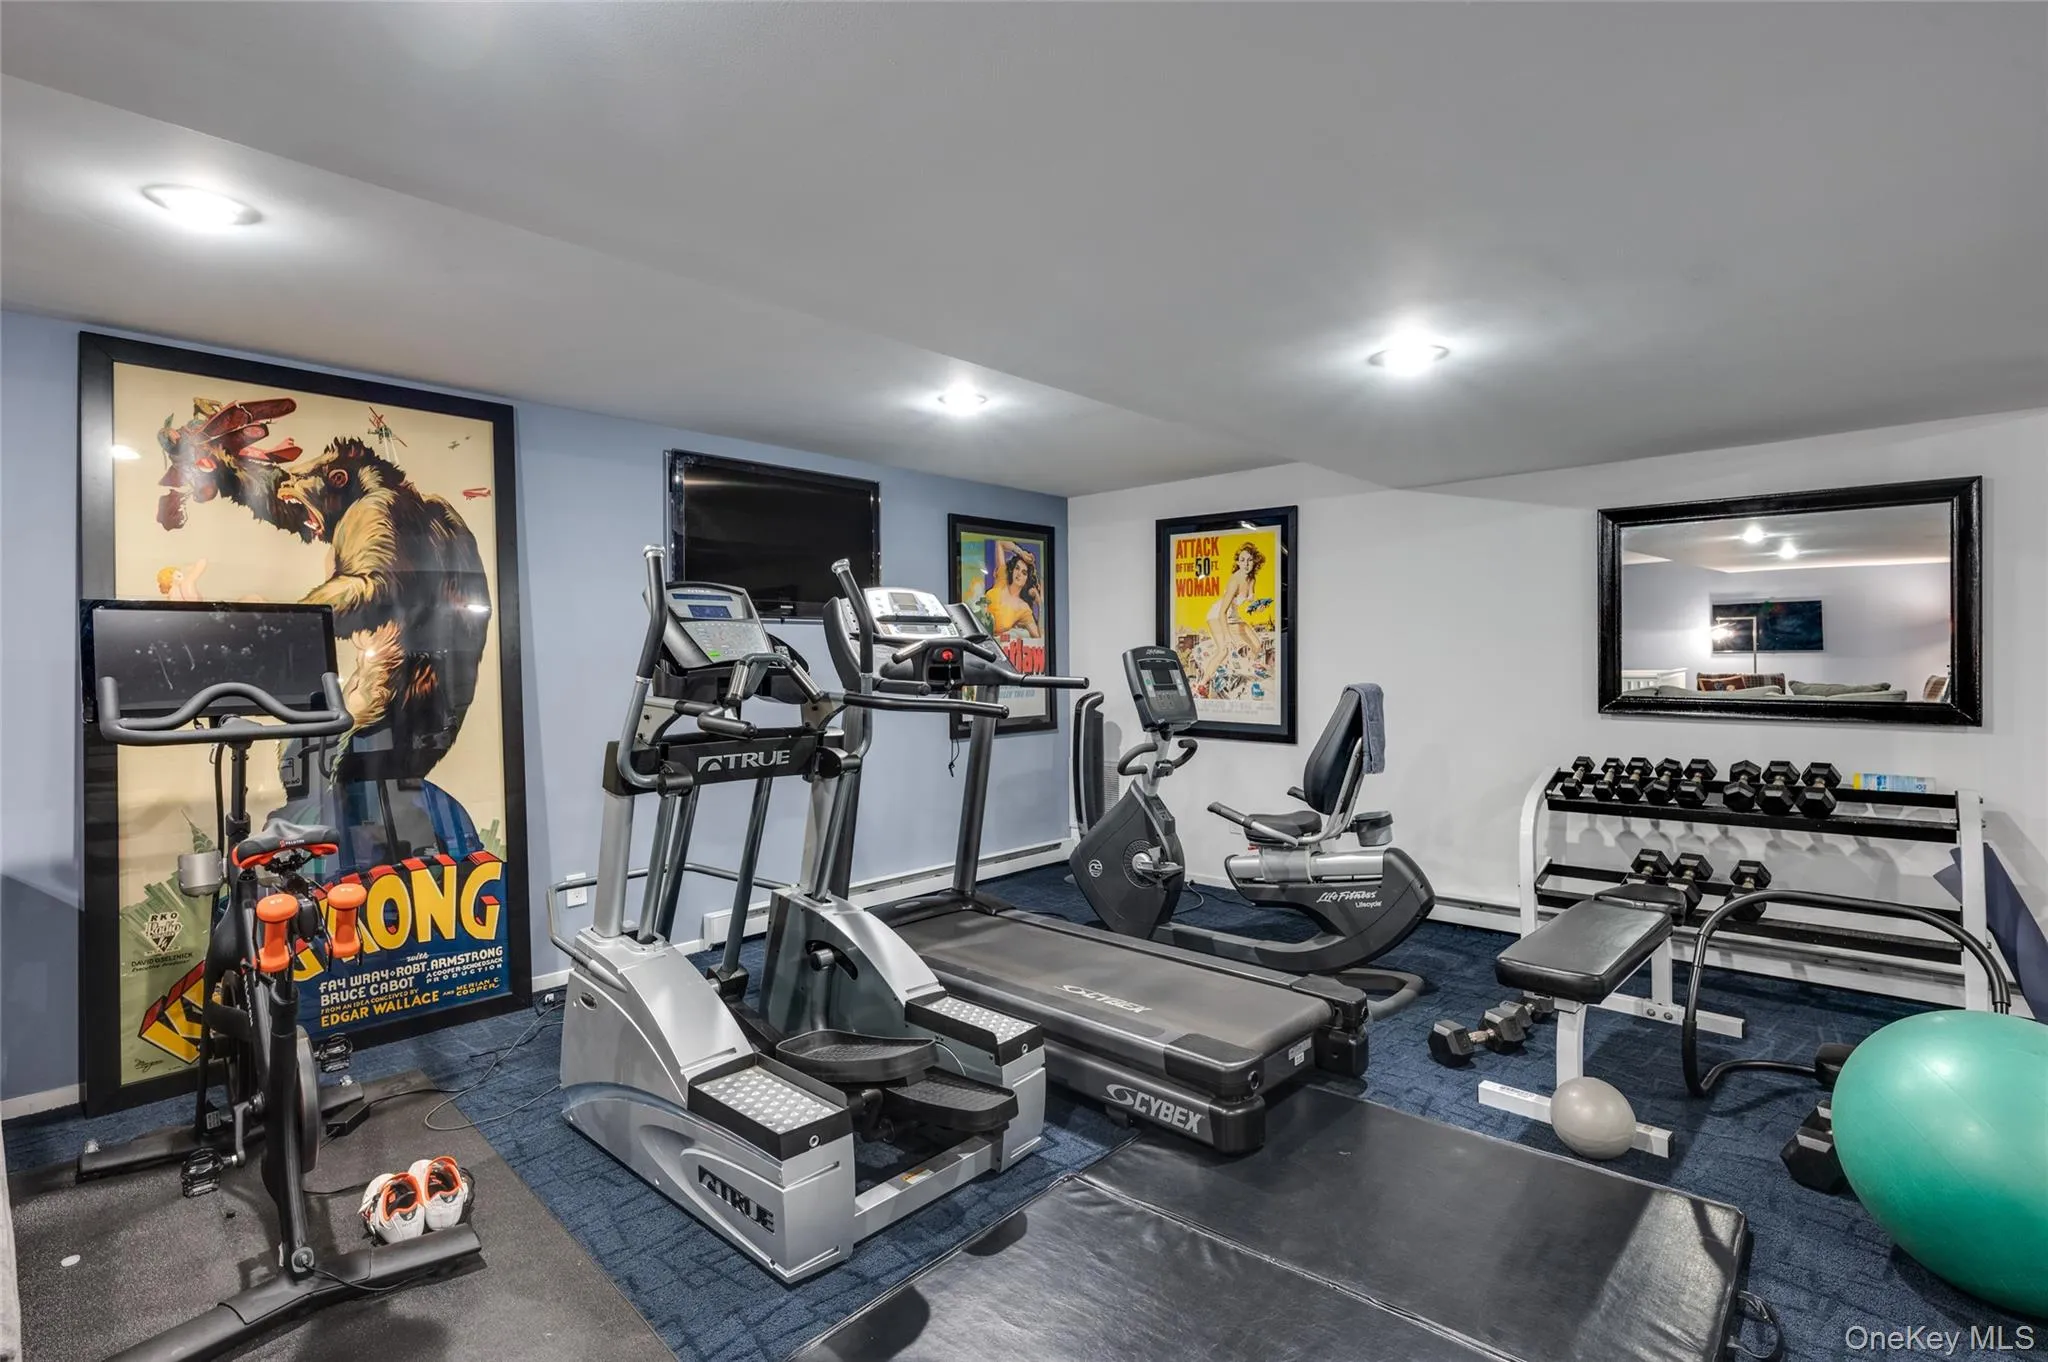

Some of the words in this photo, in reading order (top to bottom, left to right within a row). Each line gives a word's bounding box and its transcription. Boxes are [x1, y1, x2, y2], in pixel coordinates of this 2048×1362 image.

[1176, 537, 1220, 559] ATTACK
[1184, 562, 1194, 572] THE
[1195, 557, 1211, 577] 50
[1176, 577, 1220, 597] WOMAN
[723, 750, 790, 769] TRUE
[1316, 891, 1338, 903] Life
[1337, 891, 1377, 902] Fitness
[151, 912, 178, 921] RKO
[131, 958, 154, 967] DAVID
[406, 951, 429, 962] with
[319, 978, 346, 993] FAY
[350, 969, 389, 987] WRAY
[396, 961, 430, 978] ROBT.
[431, 946, 503, 971] ARMSTRONG
[426, 964, 502, 983] PRODUCTION
[321, 986, 367, 1007] BRUCE
[369, 976, 415, 997] CABOT
[456, 979, 490, 991] MERIAN
[456, 982, 495, 997] COOPER
[321, 1005, 341, 1014] FROM
[353, 999, 370, 1008] IDEA
[370, 990, 408, 1004] CONCEIVED
[321, 1006, 369, 1028] EDGAR
[373, 990, 439, 1015] WALLACE
[1086, 991, 1152, 1013] CYBEX
[1134, 1092, 1203, 1134] CYBEX
[716, 1179, 774, 1233] TRUE
